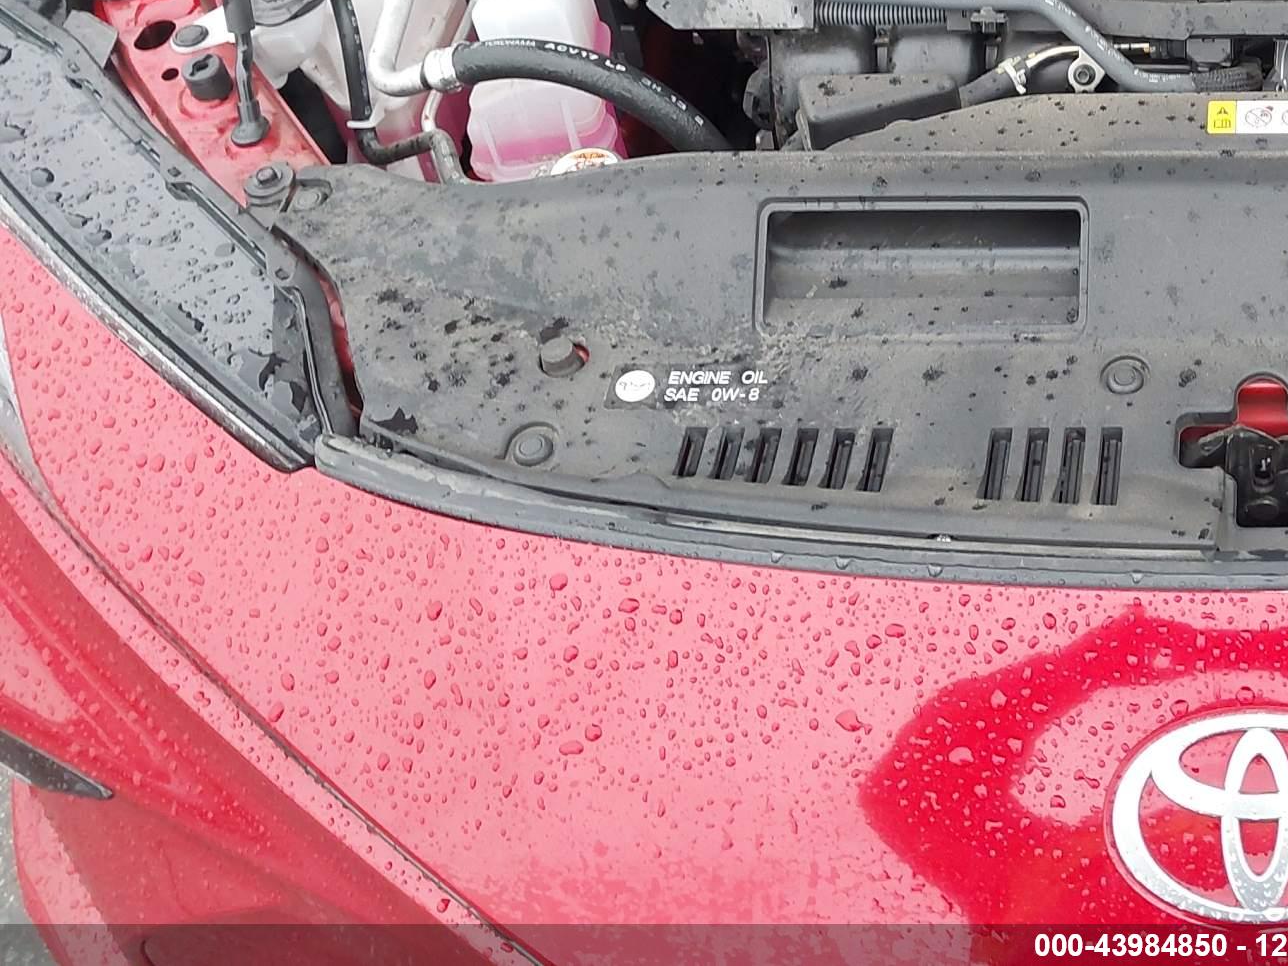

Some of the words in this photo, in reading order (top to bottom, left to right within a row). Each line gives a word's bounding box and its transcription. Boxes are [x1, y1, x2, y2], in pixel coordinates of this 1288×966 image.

[668, 370, 732, 385] ENGINE
[741, 370, 768, 385] OIL
[663, 387, 700, 402] SAE
